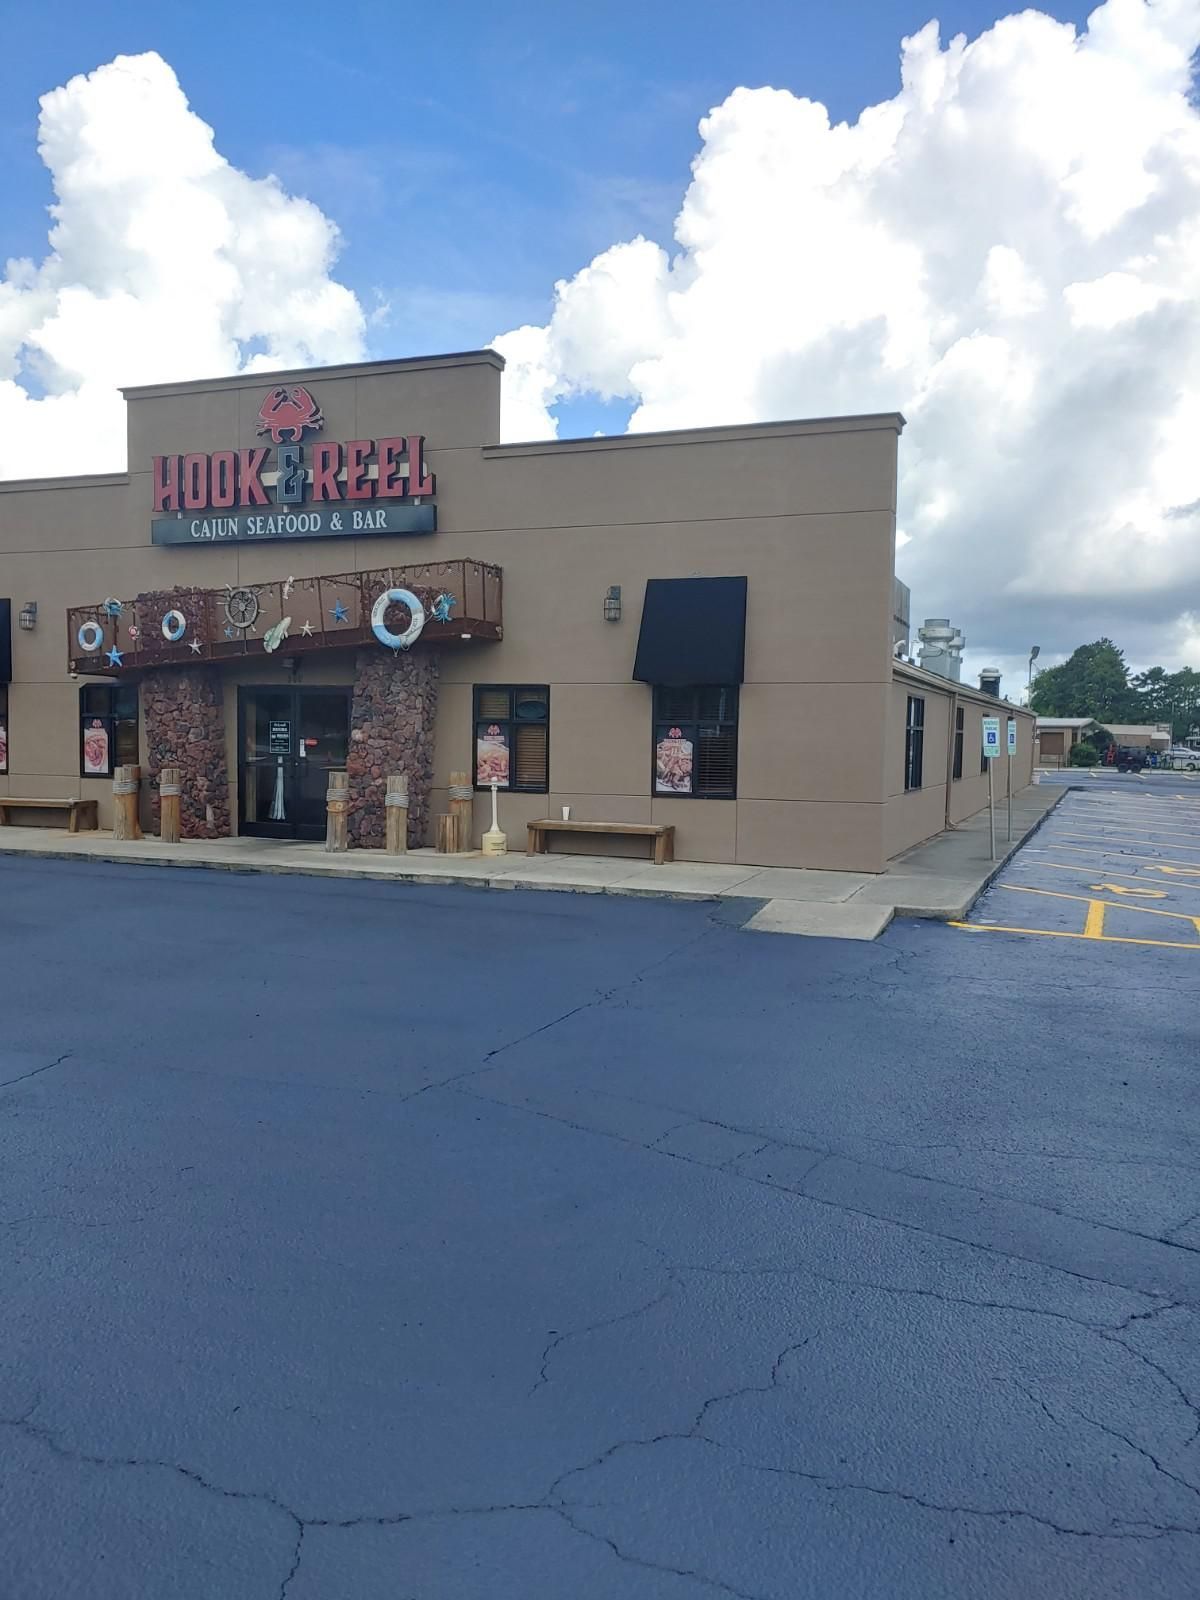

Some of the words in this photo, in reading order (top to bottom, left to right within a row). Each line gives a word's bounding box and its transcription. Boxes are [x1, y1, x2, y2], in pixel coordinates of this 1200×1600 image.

[152, 449, 271, 512] HOOK
[276, 445, 308, 504] &
[312, 435, 436, 500] REEL
[190, 518, 239, 540] CAJUN
[247, 514, 322, 535] SEAFOOD
[330, 513, 343, 530] &
[353, 510, 387, 529] BAR
